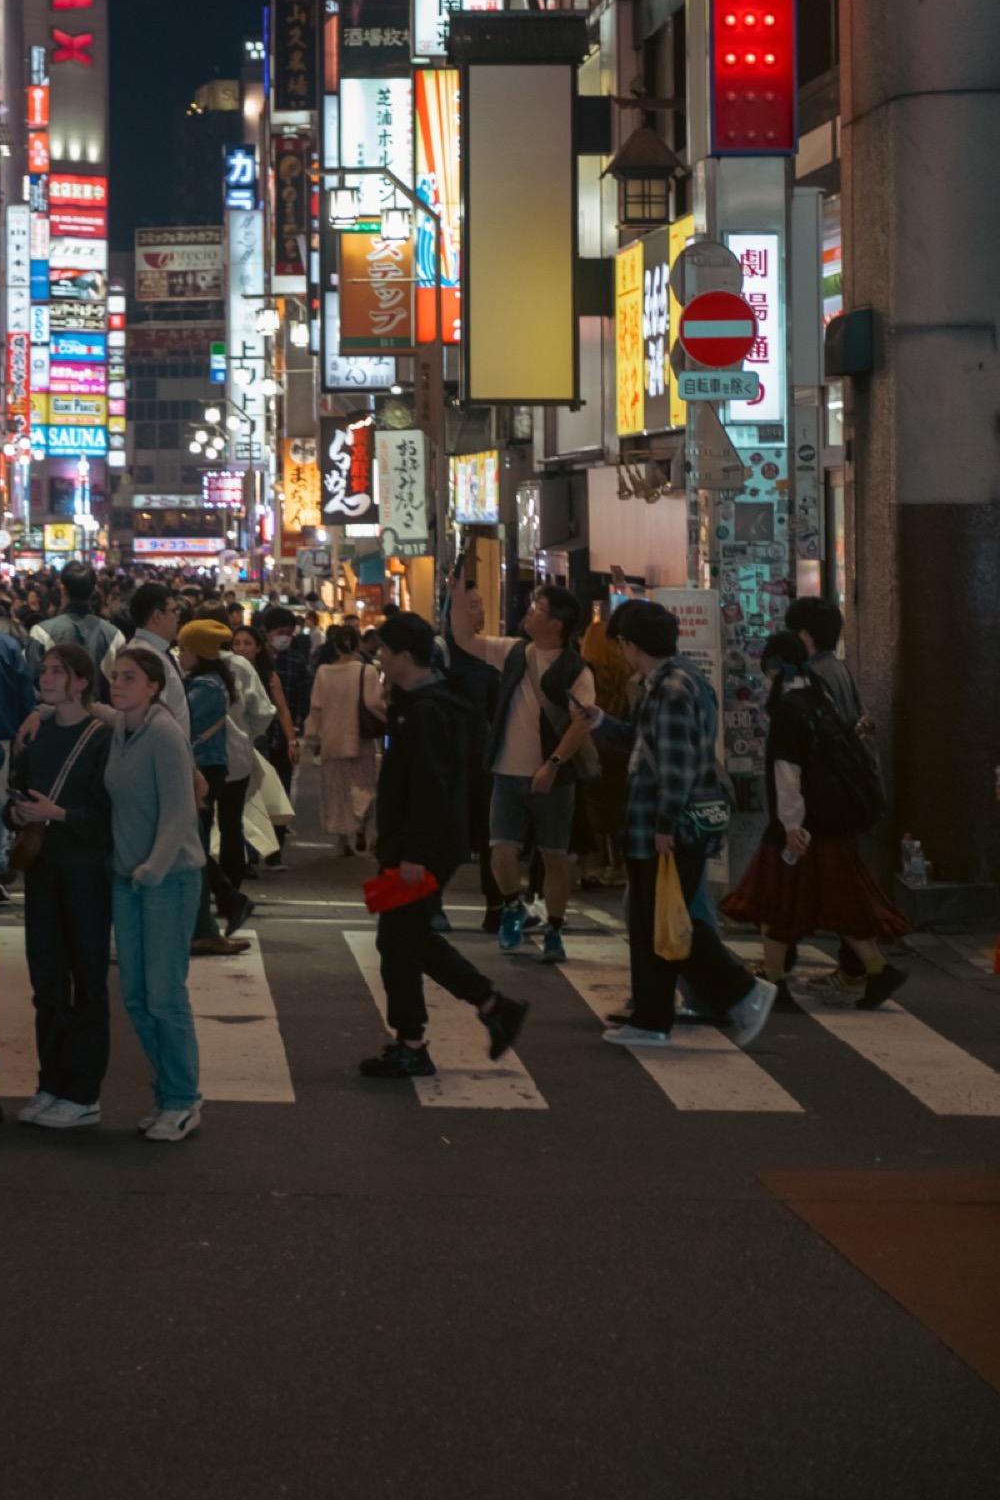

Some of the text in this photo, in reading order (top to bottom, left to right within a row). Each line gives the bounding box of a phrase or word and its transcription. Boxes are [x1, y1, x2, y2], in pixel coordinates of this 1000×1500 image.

[684, 378, 753, 394] 自転車を除く
[49, 428, 106, 447] SAUNA
